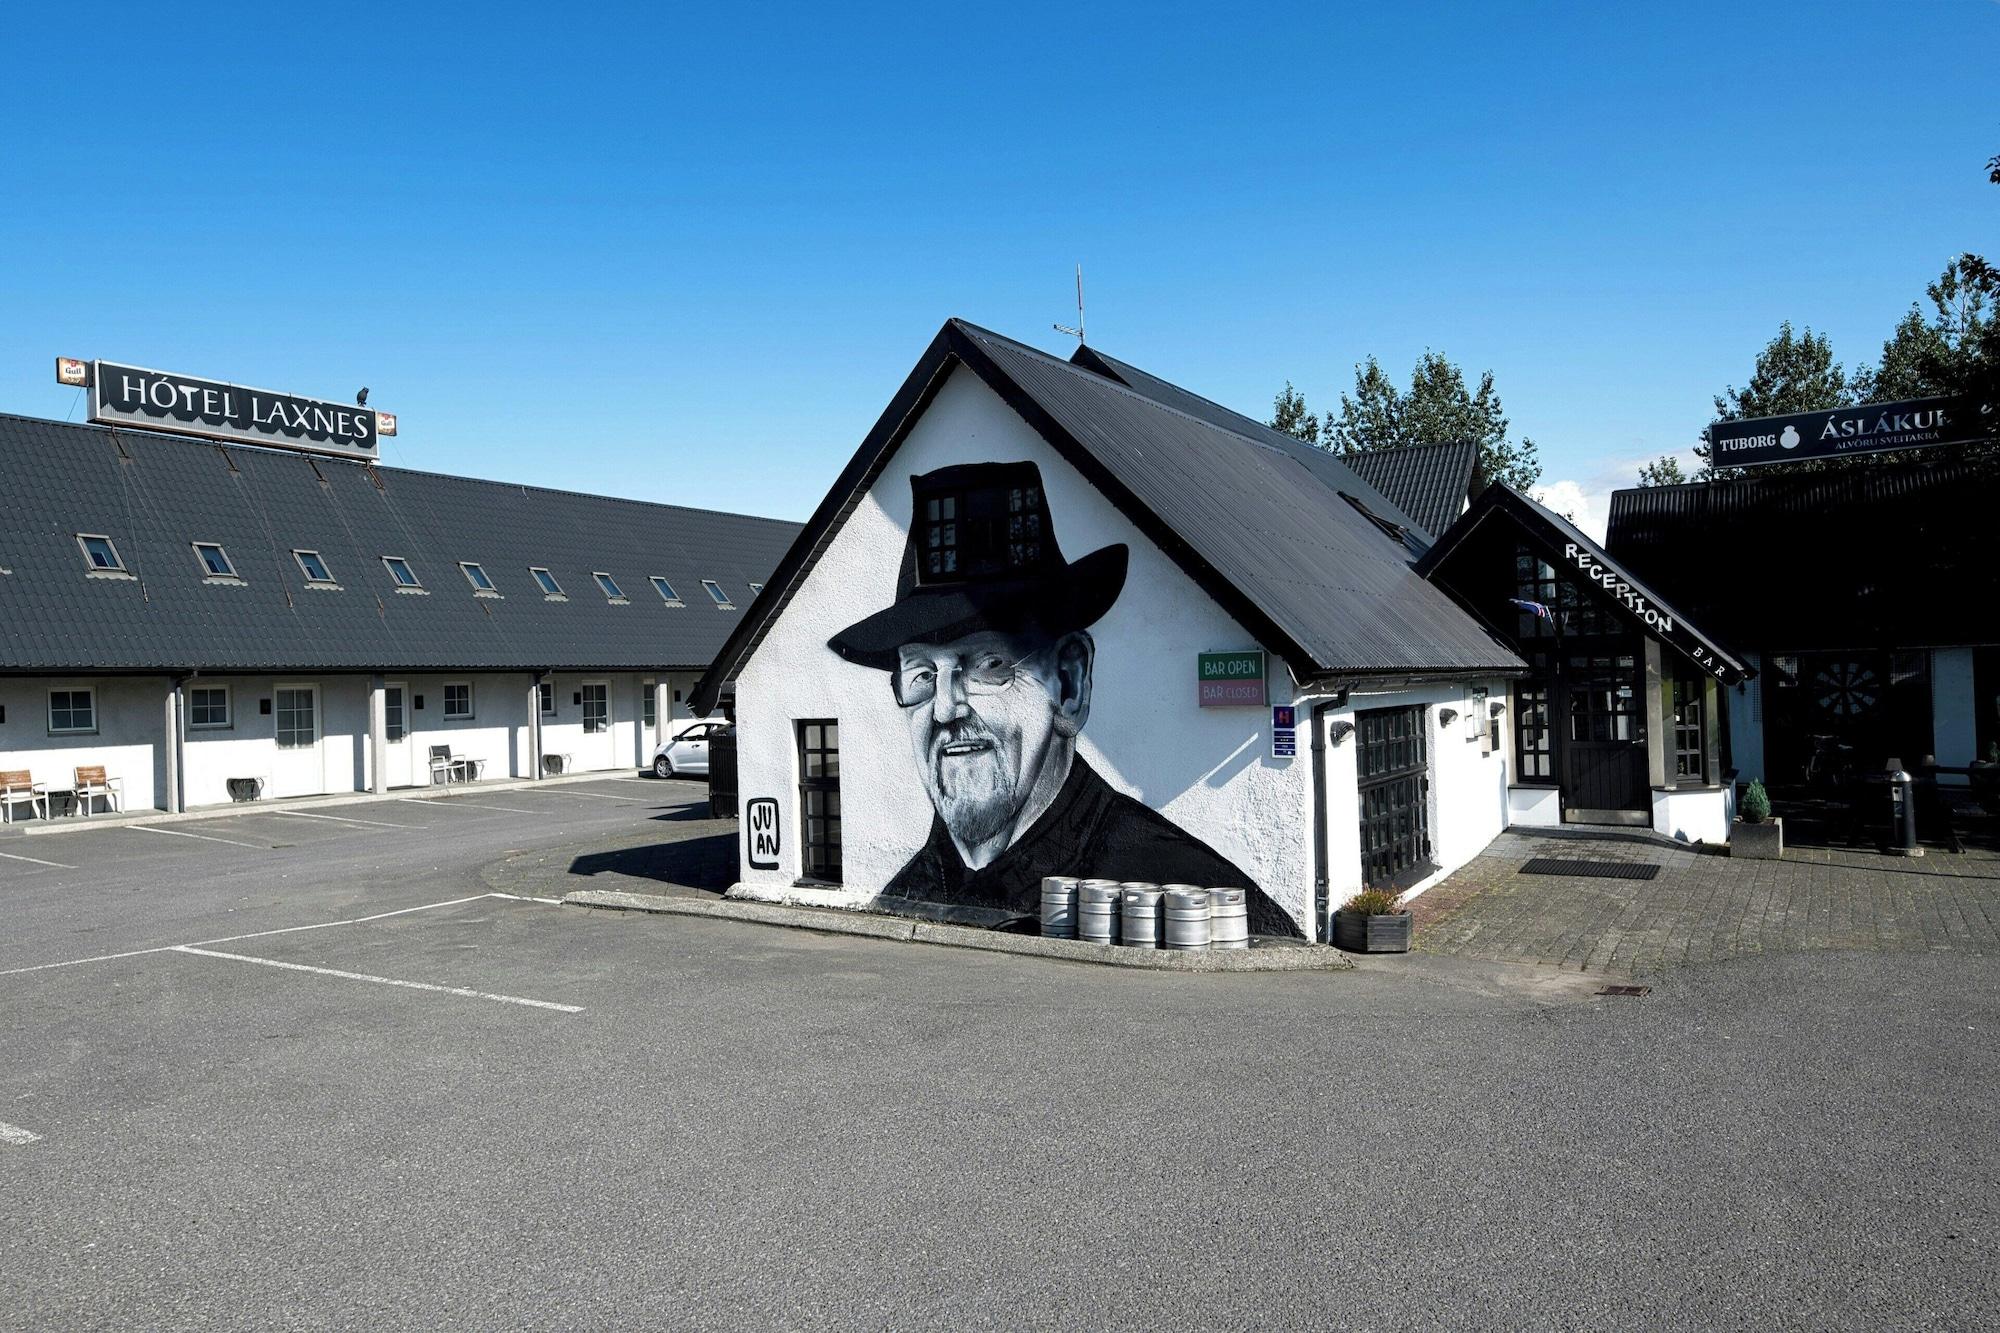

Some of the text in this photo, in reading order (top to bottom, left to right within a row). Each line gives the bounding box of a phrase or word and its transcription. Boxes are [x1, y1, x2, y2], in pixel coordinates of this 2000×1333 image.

[122, 375, 368, 439] HÓTEL LAXNES
[1720, 434, 1776, 451] TUBORG
[1565, 543, 1673, 633] RECEPTION
[1205, 660, 1256, 675] BAR OPEN
[1693, 646, 1726, 677] BAR
[1203, 685, 1258, 699] BAR CLOSED
